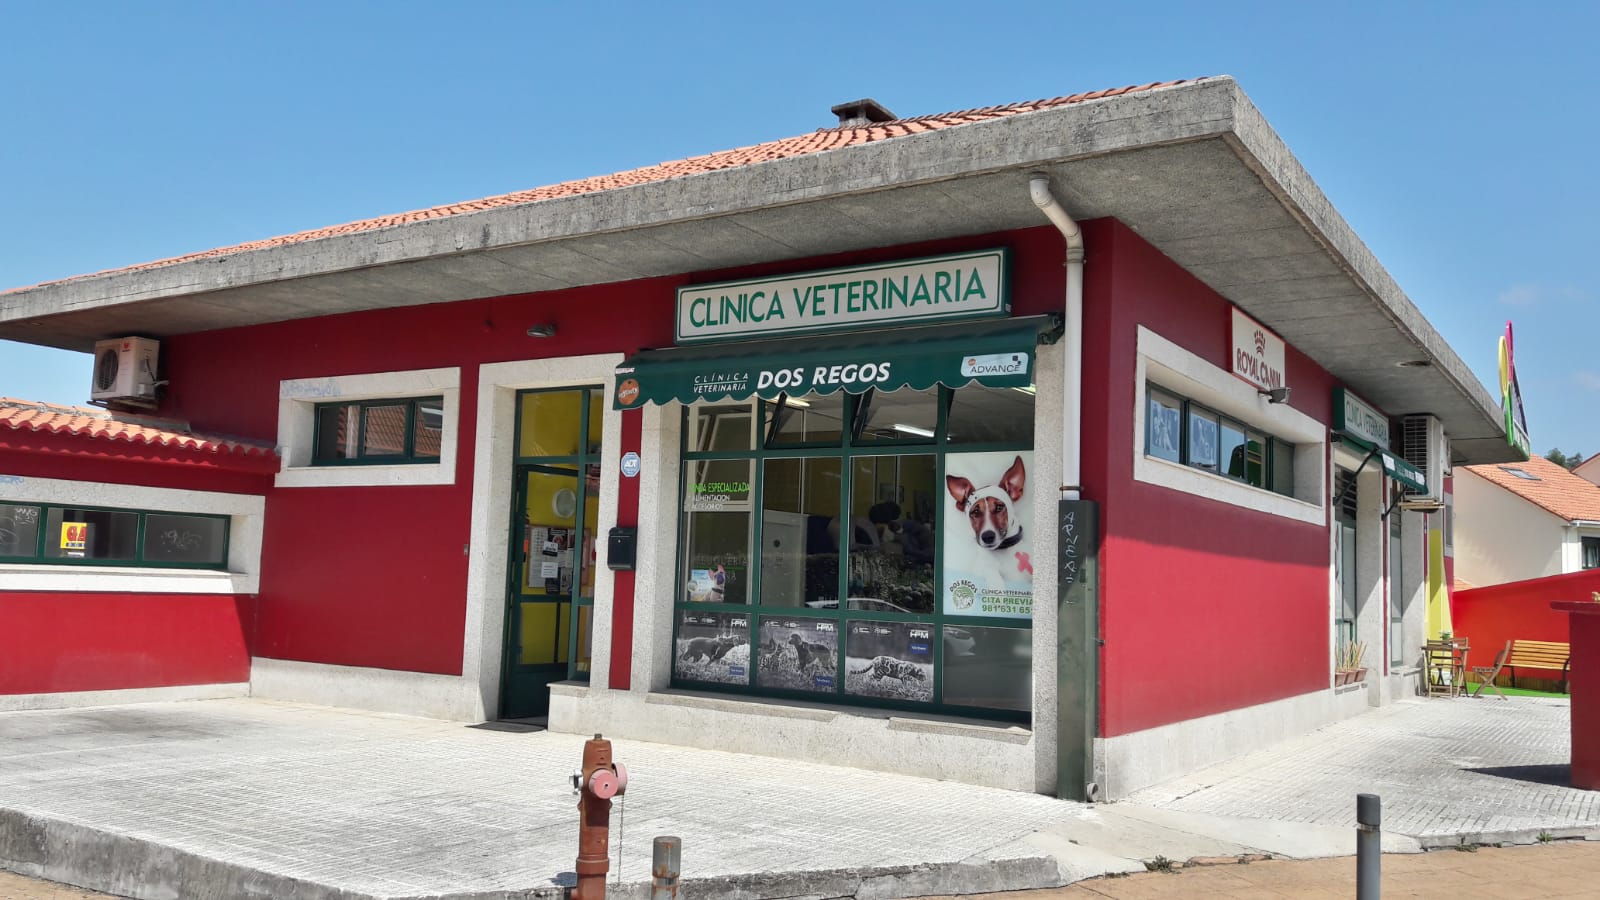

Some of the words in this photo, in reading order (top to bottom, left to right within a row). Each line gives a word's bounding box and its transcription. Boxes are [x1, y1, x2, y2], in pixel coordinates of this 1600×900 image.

[689, 290, 785, 328] CLINICA
[792, 266, 986, 317] VETERINARIA
[970, 364, 1021, 374] ADVANCE
[1236, 347, 1260, 381] ROYAL
[694, 373, 748, 384] CLÍNICA
[757, 367, 804, 390] DOS
[812, 361, 891, 385] REGOS
[693, 383, 747, 394] VETERINARIA
[708, 482, 751, 492] ESPECIALIZADA
[982, 596, 1000, 604] CITA
[1002, 597, 1033, 605] PREVIA
[1018, 606, 1033, 614] 65
